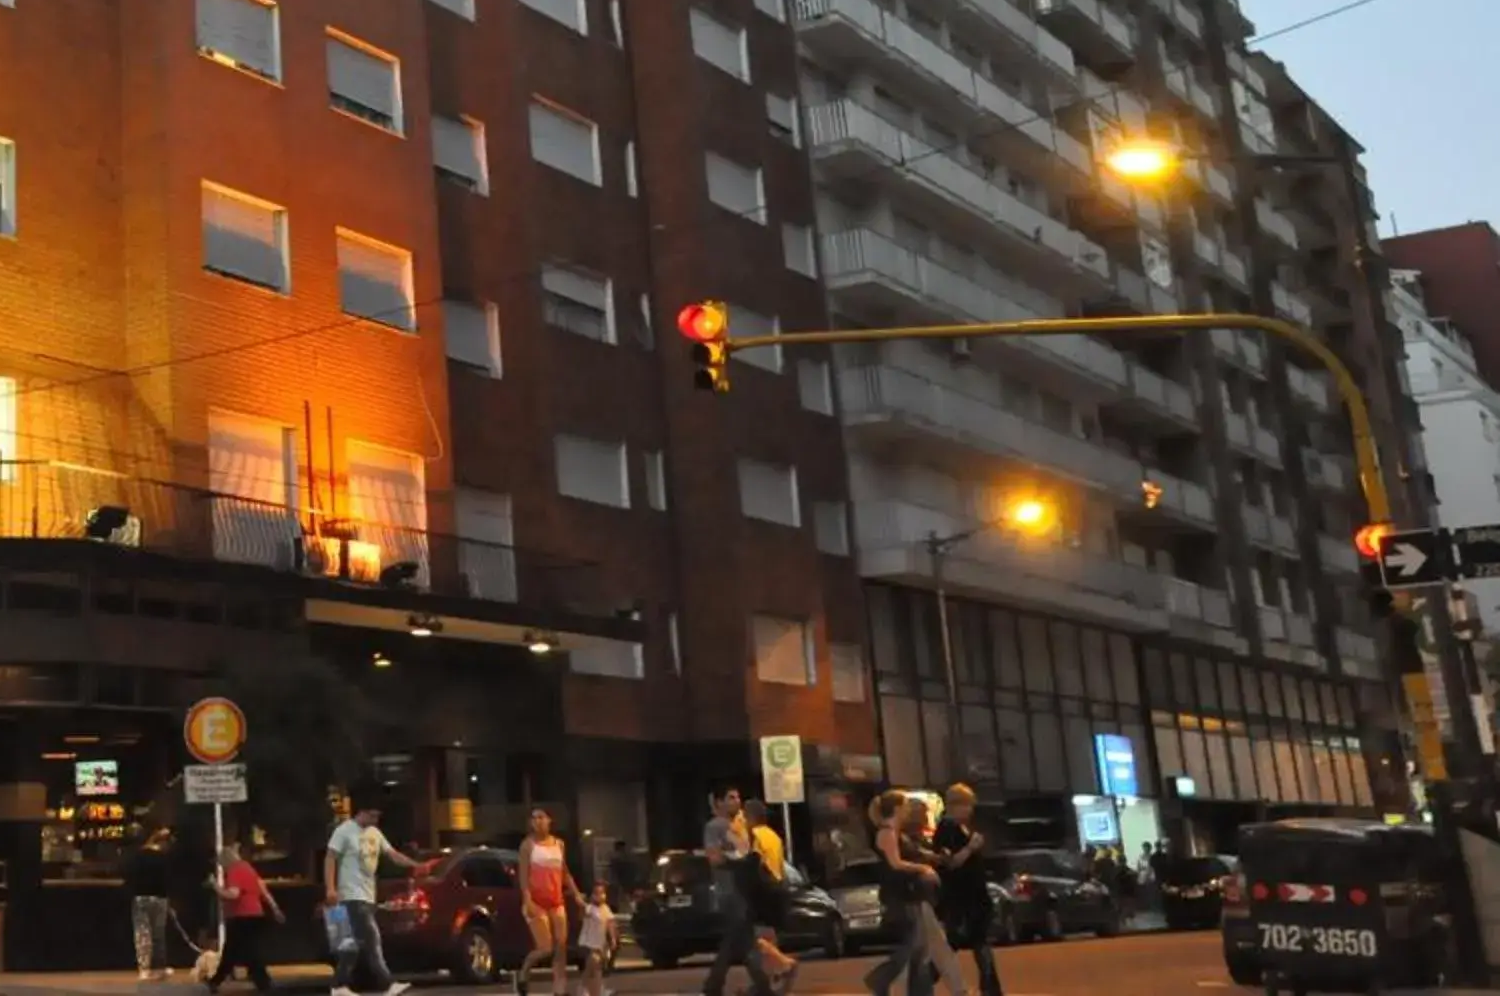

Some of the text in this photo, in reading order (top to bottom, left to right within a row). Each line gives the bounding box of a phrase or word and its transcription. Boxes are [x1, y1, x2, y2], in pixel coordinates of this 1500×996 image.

[201, 711, 229, 750] E
[773, 745, 791, 763] E
[1313, 927, 1377, 957] 3650
